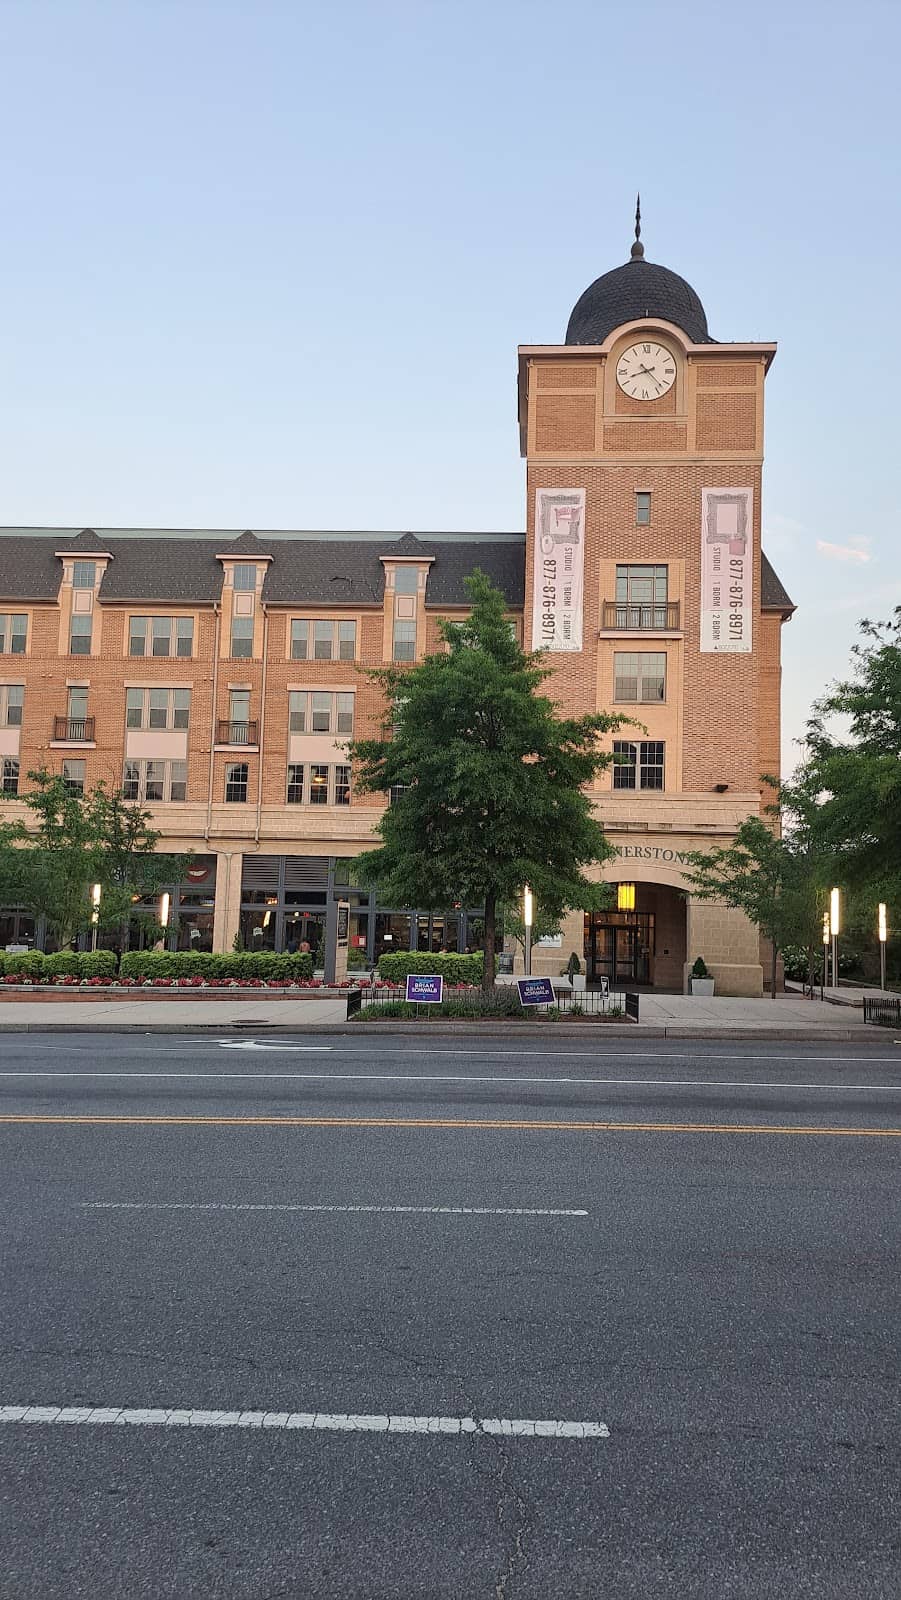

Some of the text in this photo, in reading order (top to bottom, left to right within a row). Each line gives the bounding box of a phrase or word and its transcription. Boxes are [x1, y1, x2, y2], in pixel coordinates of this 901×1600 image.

[564, 547, 573, 571] STUDIO
[712, 547, 721, 571] STUDIO
[542, 559, 557, 641] 877-876-8971
[563, 586, 572, 607] BDRM
[712, 586, 721, 607] BDRM
[729, 559, 743, 641] 877-876-8971
[712, 620, 721, 641] BDRM
